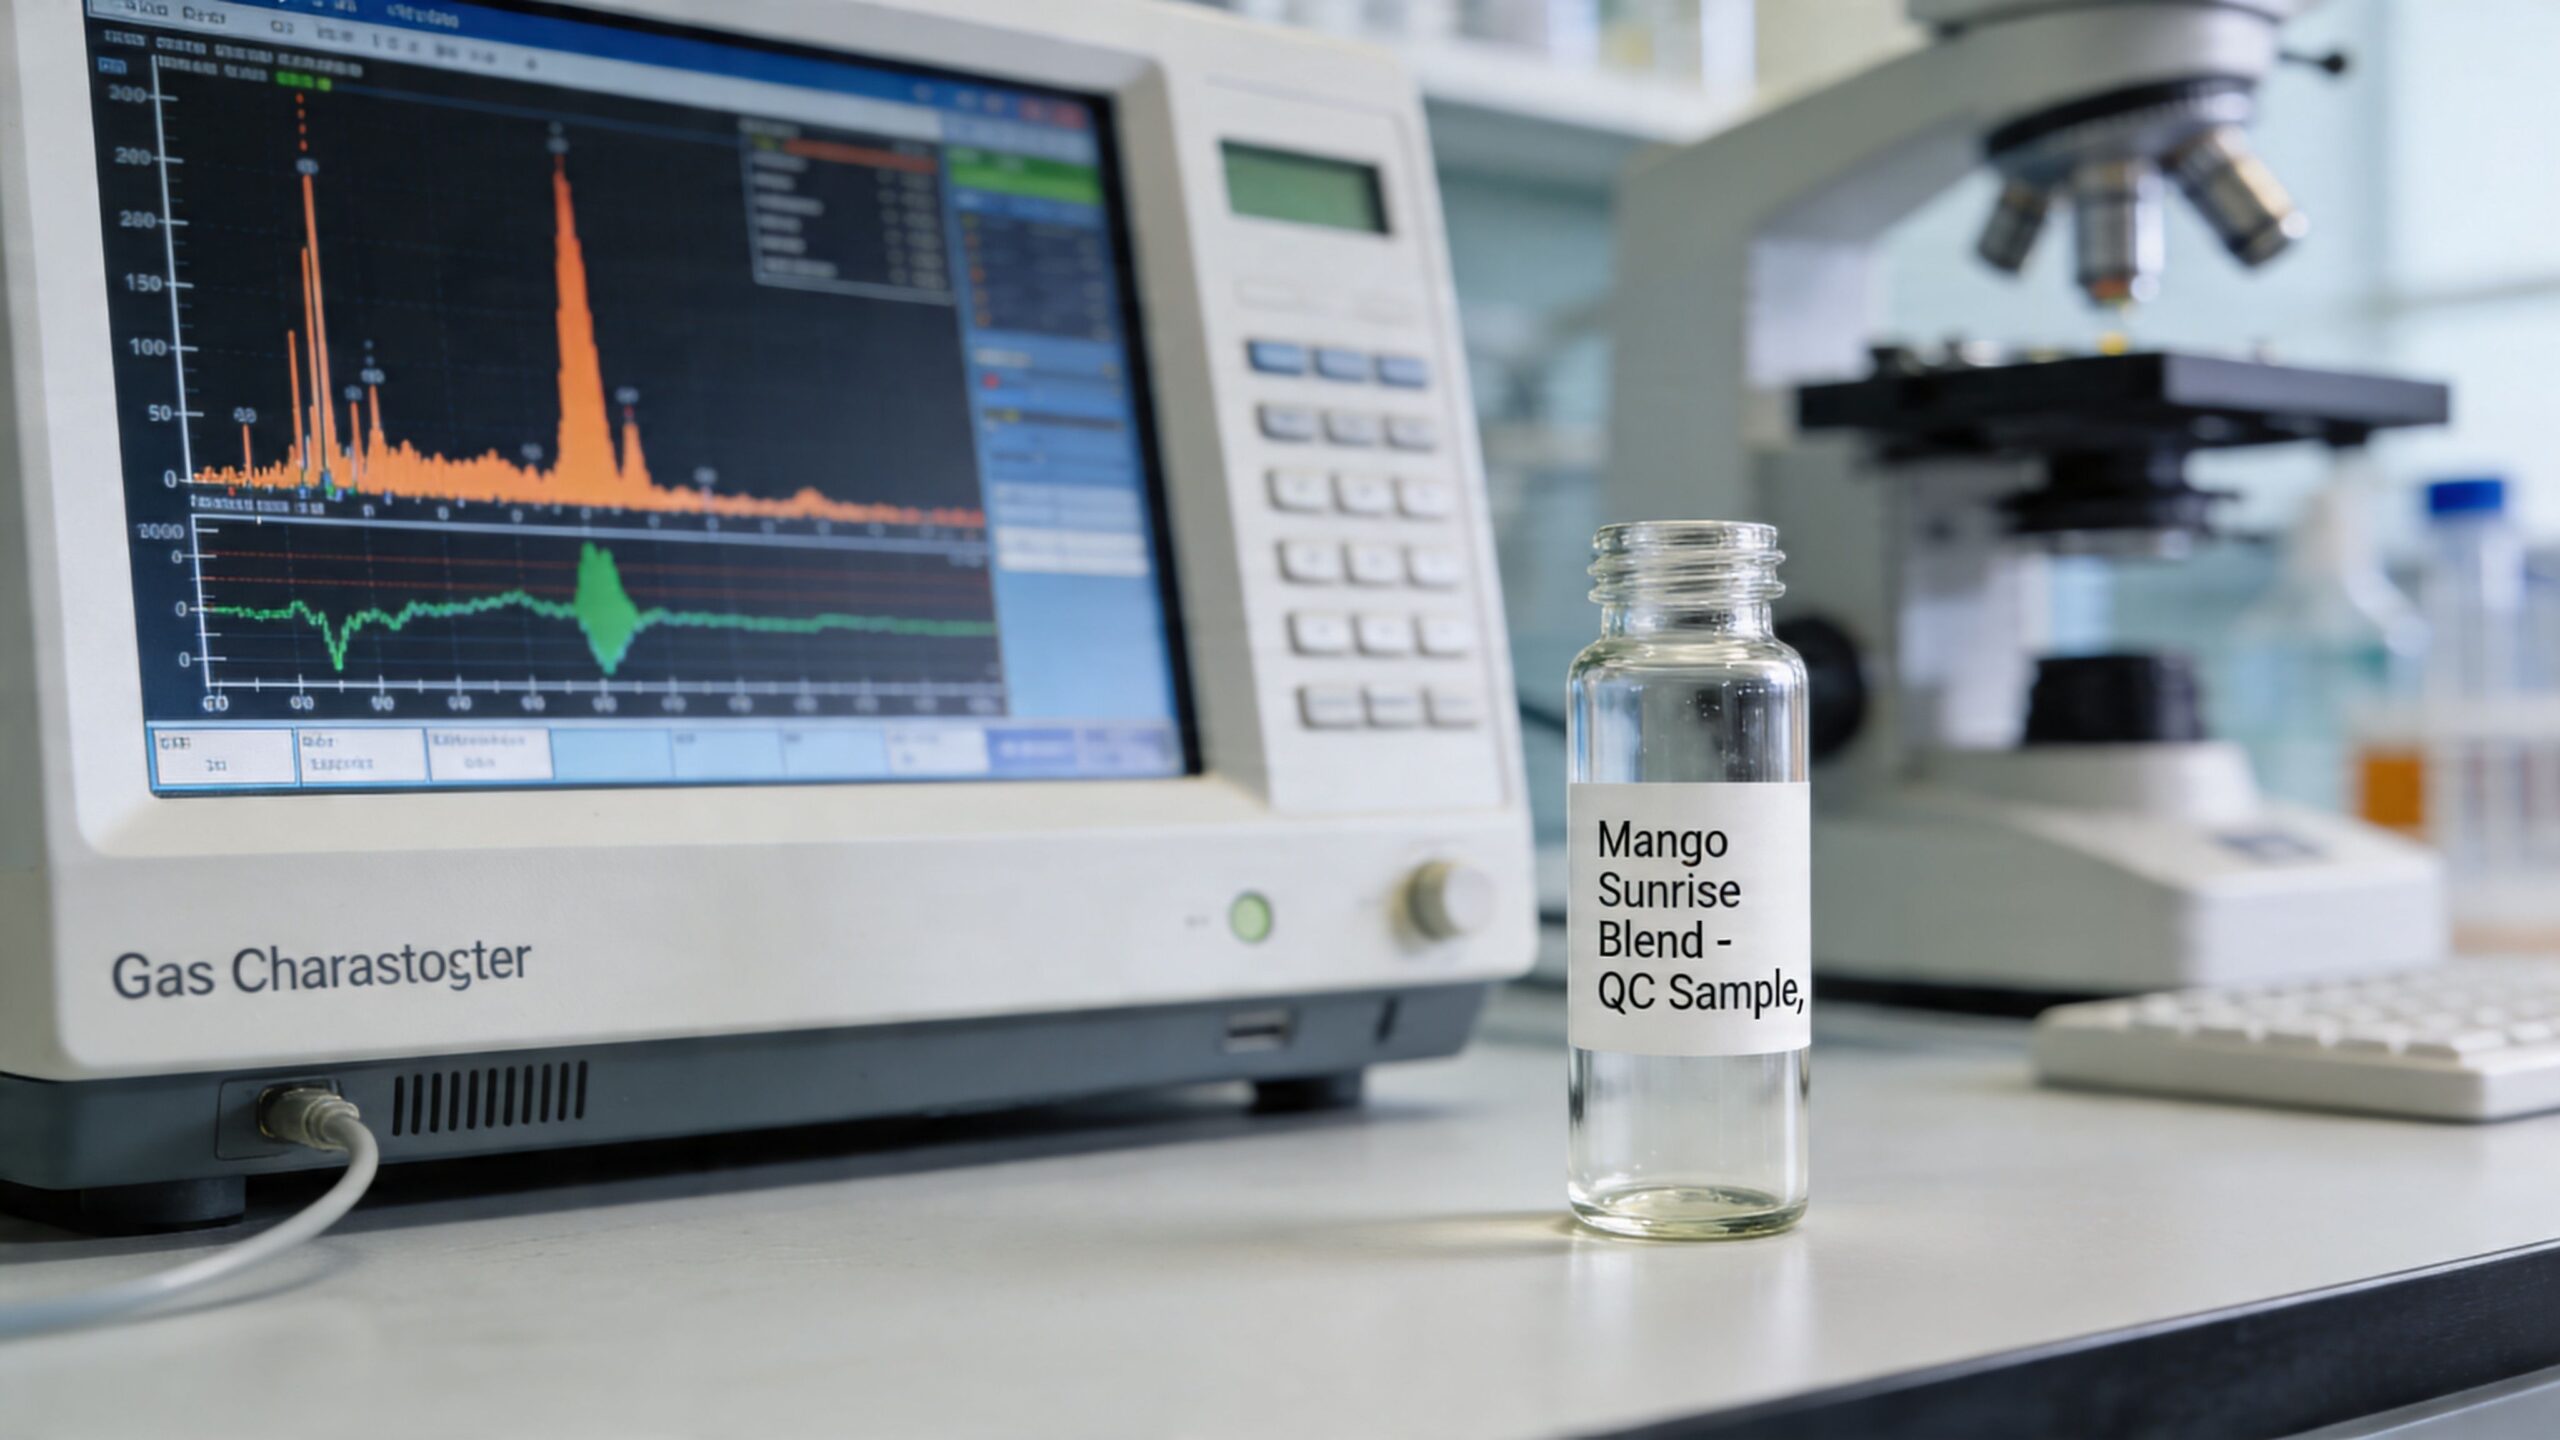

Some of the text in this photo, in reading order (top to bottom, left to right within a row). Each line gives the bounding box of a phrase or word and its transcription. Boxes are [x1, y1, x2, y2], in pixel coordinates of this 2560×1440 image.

[126, 273, 162, 292] 150
[130, 337, 167, 356] 100
[148, 404, 172, 421] 50
[164, 469, 178, 489] 0
[1598, 820, 1729, 867] Mango
[1598, 871, 1742, 908] Sunrise
[1598, 919, 1704, 958] Blend
[112, 951, 216, 1000] Gas
[1598, 967, 1805, 1020] QC Sample,
